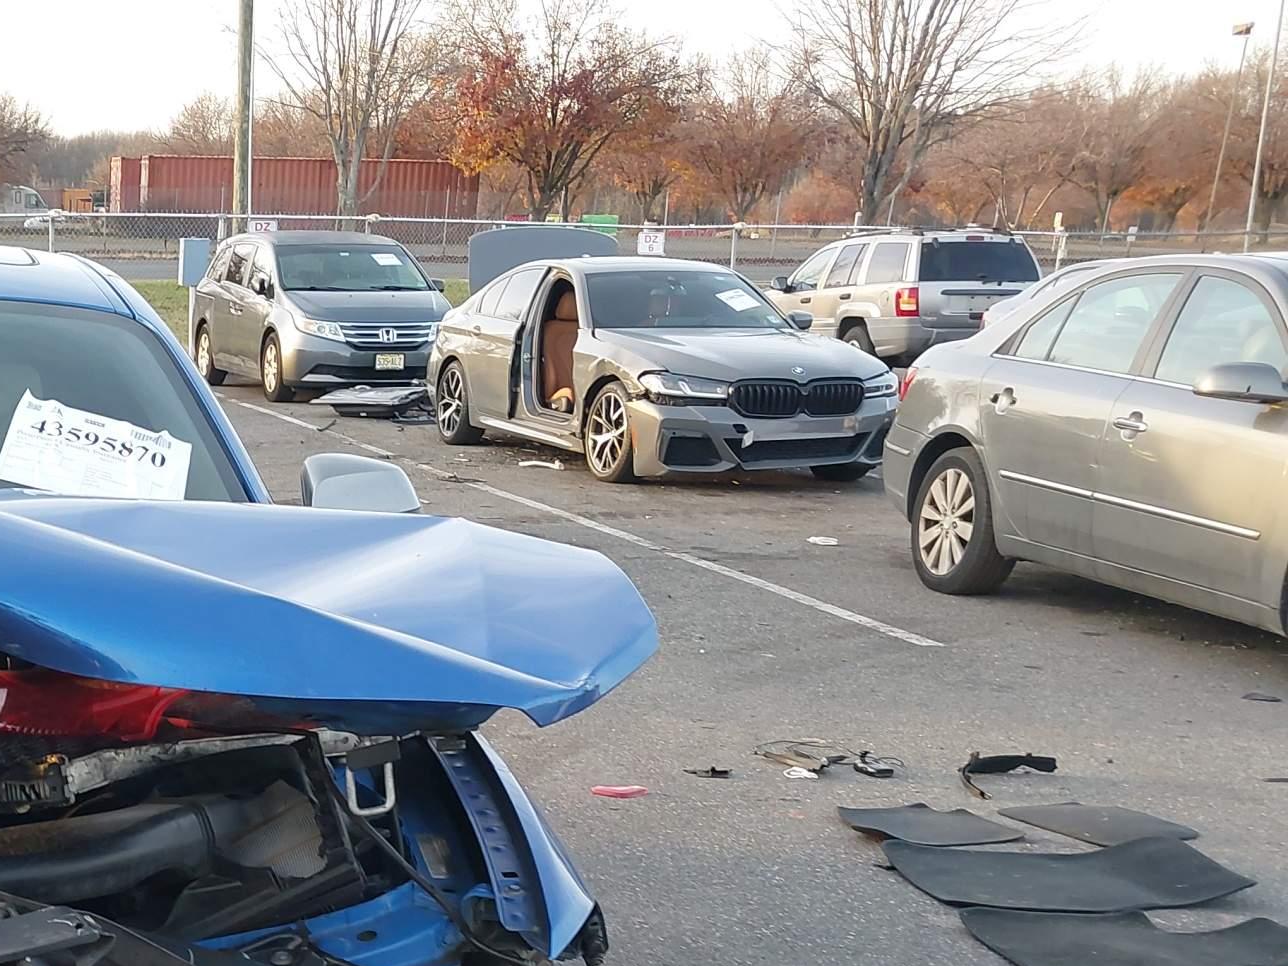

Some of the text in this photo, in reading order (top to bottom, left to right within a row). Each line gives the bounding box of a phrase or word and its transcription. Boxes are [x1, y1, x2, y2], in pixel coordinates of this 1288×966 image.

[255, 222, 271, 231] DZ
[644, 235, 659, 243] DZ
[648, 243, 654, 252] 6
[30, 419, 166, 468] 43595870
